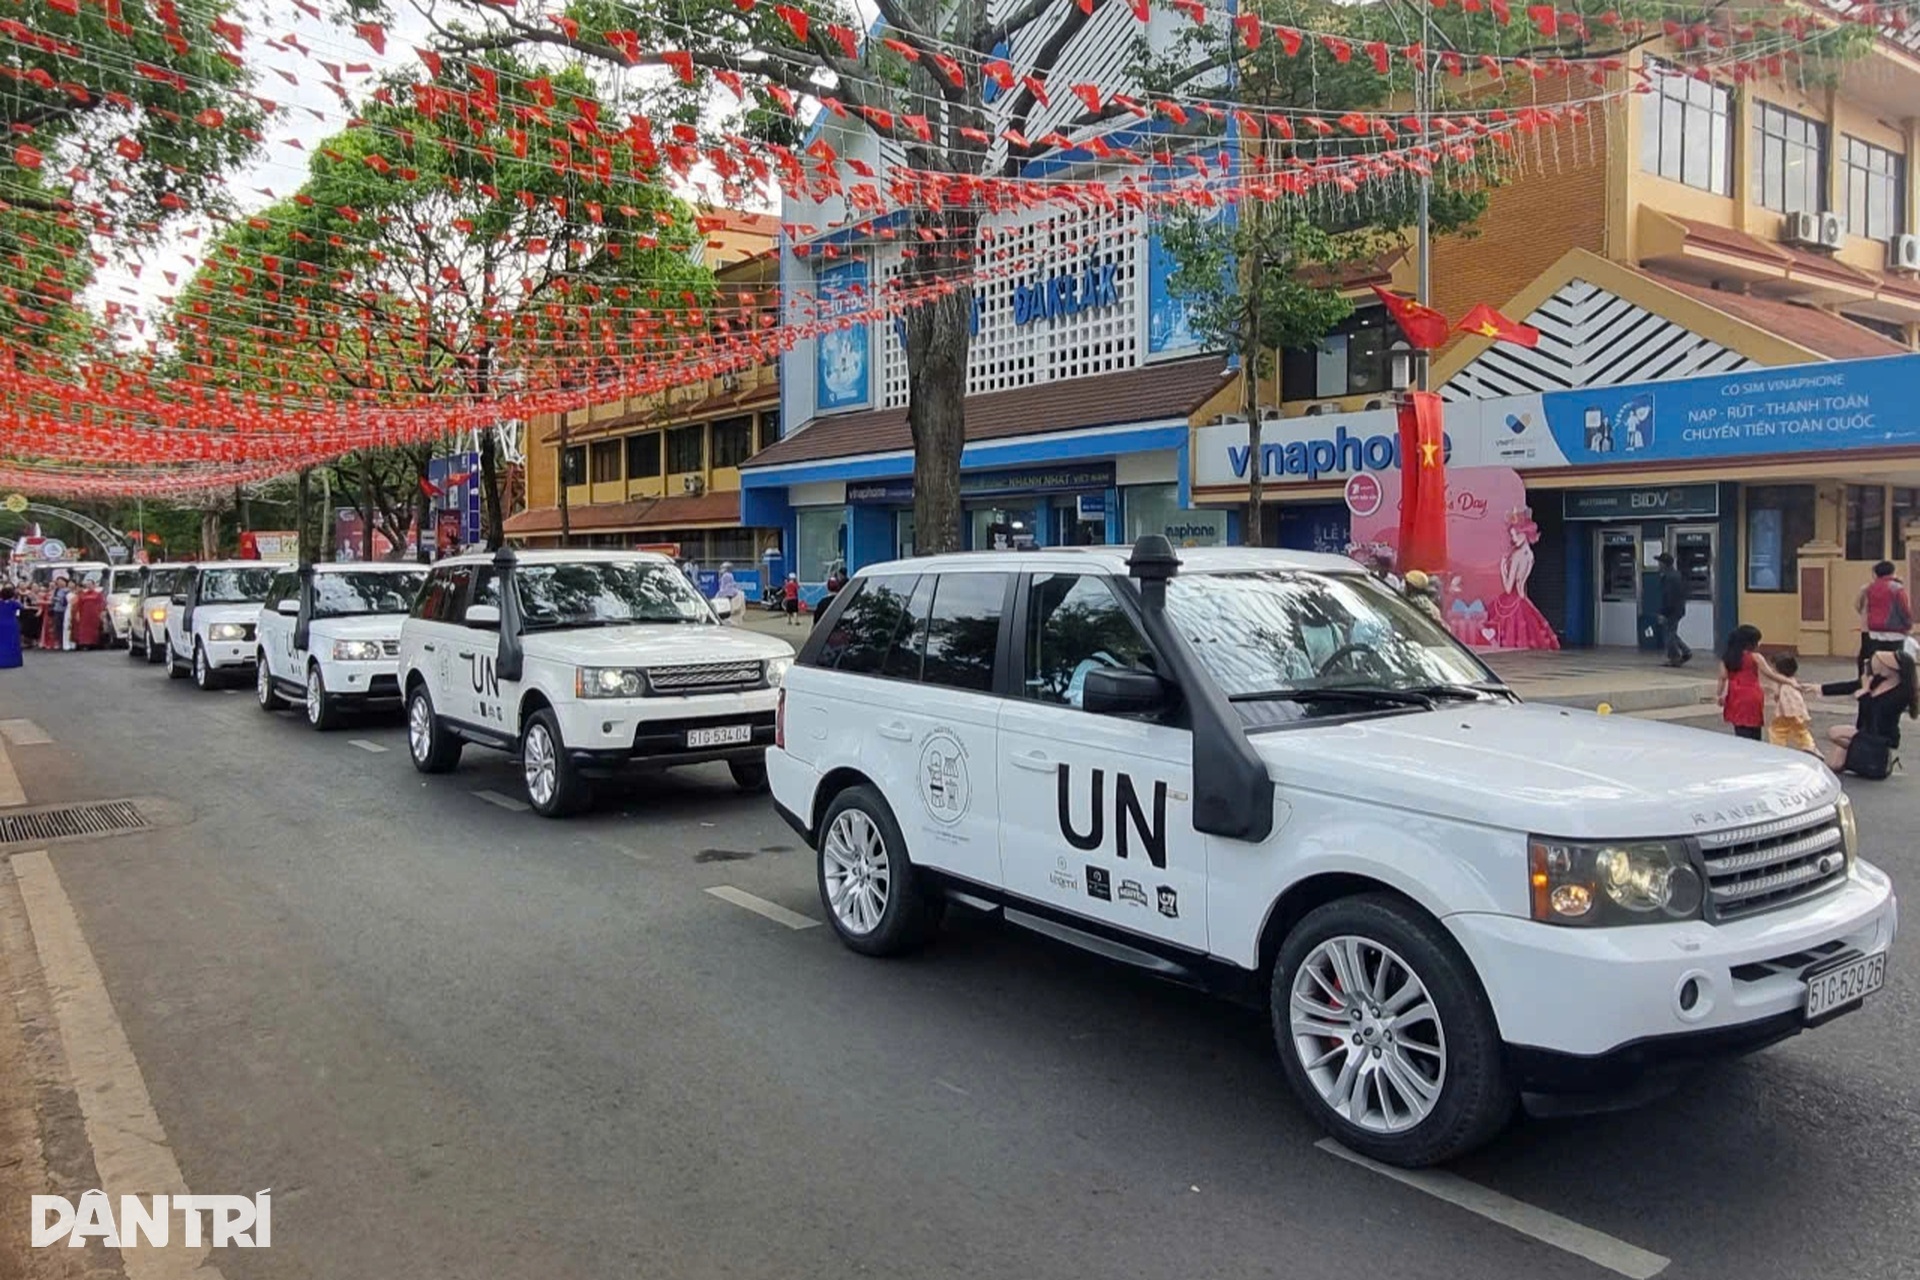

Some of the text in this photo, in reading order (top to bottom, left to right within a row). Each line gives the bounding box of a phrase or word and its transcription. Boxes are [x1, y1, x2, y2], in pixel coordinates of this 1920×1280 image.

[1767, 373, 1845, 392] VINAPHONE
[1765, 400, 1819, 415] THANH
[1457, 492, 1488, 513] Day
[1631, 491, 1669, 509] BIDV
[1058, 762, 1167, 869] UN
